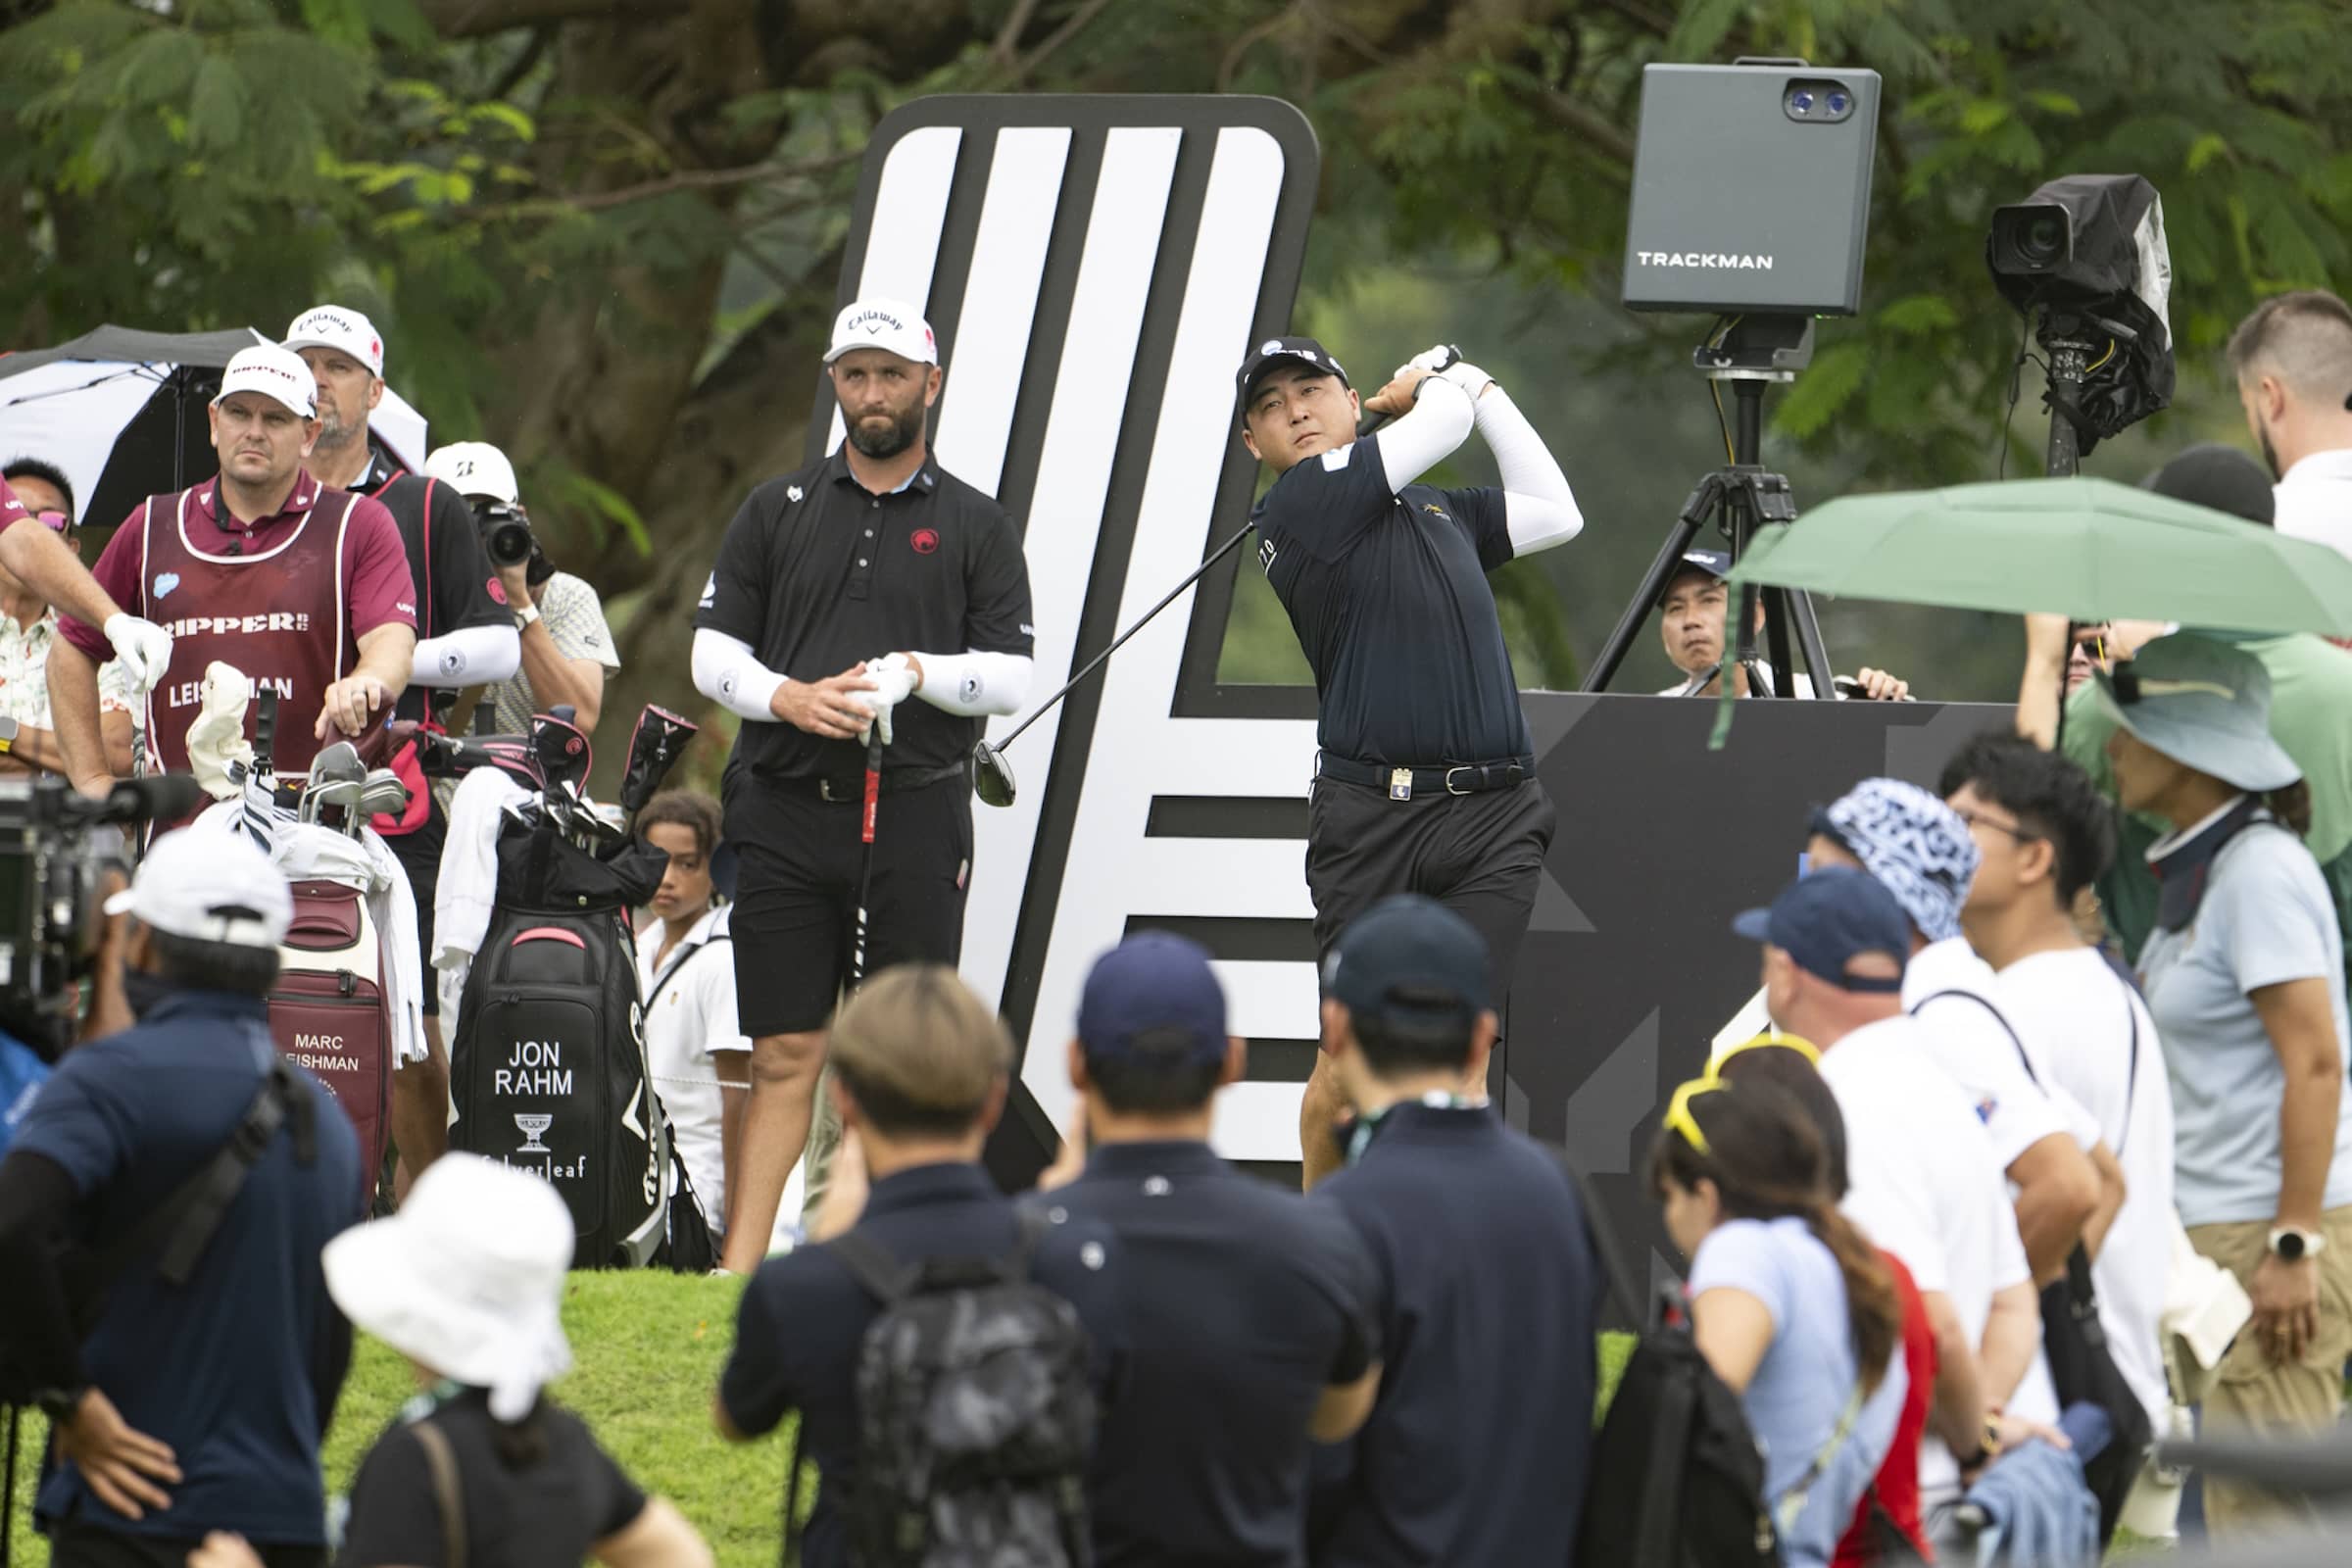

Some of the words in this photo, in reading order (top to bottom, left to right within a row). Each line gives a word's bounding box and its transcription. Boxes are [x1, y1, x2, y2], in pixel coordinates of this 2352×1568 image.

[1637, 251, 1773, 270] TRACKMAN
[298, 313, 353, 334] Callaway
[848, 310, 903, 330] Callaway
[295, 1033, 344, 1051] MARC
[284, 1053, 360, 1072] EISHMAN
[509, 1041, 561, 1067] JON
[495, 1069, 572, 1096] RAHM
